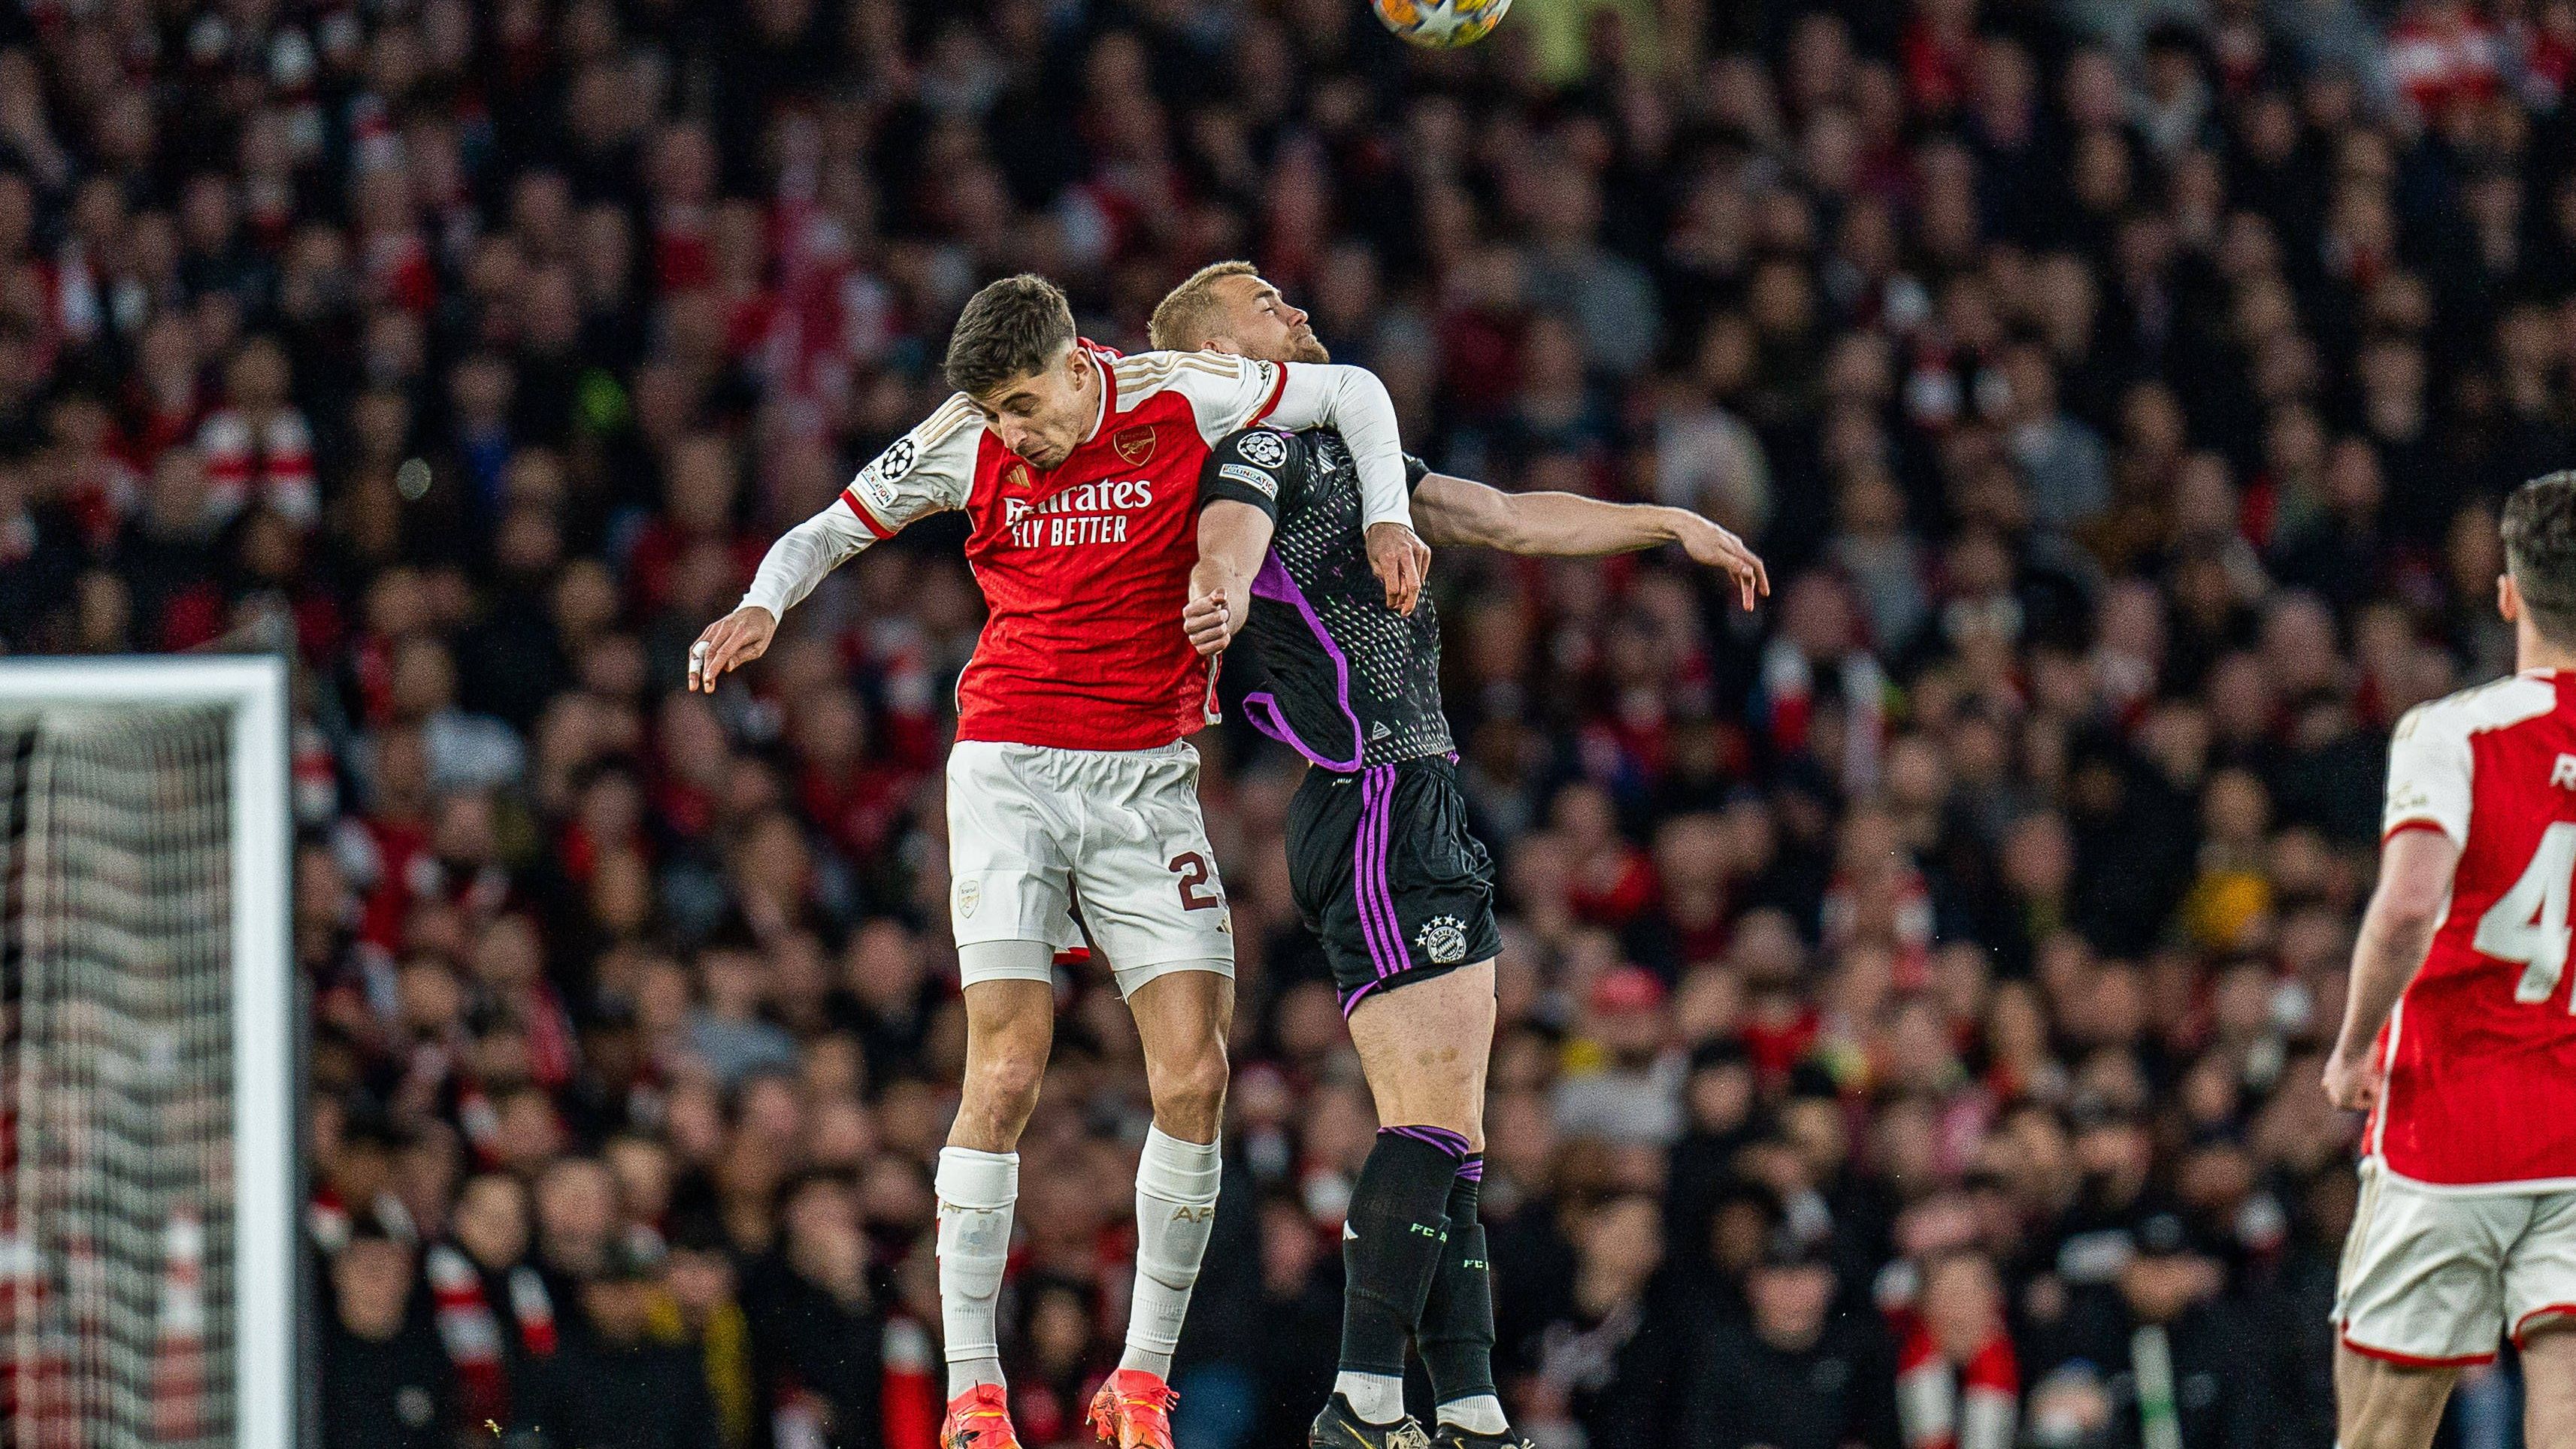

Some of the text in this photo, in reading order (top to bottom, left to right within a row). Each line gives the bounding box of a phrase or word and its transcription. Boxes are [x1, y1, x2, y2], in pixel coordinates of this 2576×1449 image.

[1012, 515, 1128, 548] FLY BETTER
[2472, 821, 2576, 1016] 4
[1172, 1205, 1212, 1224] AF
[1409, 1223, 1435, 1237] FC
[1464, 1260, 1483, 1269] FC
